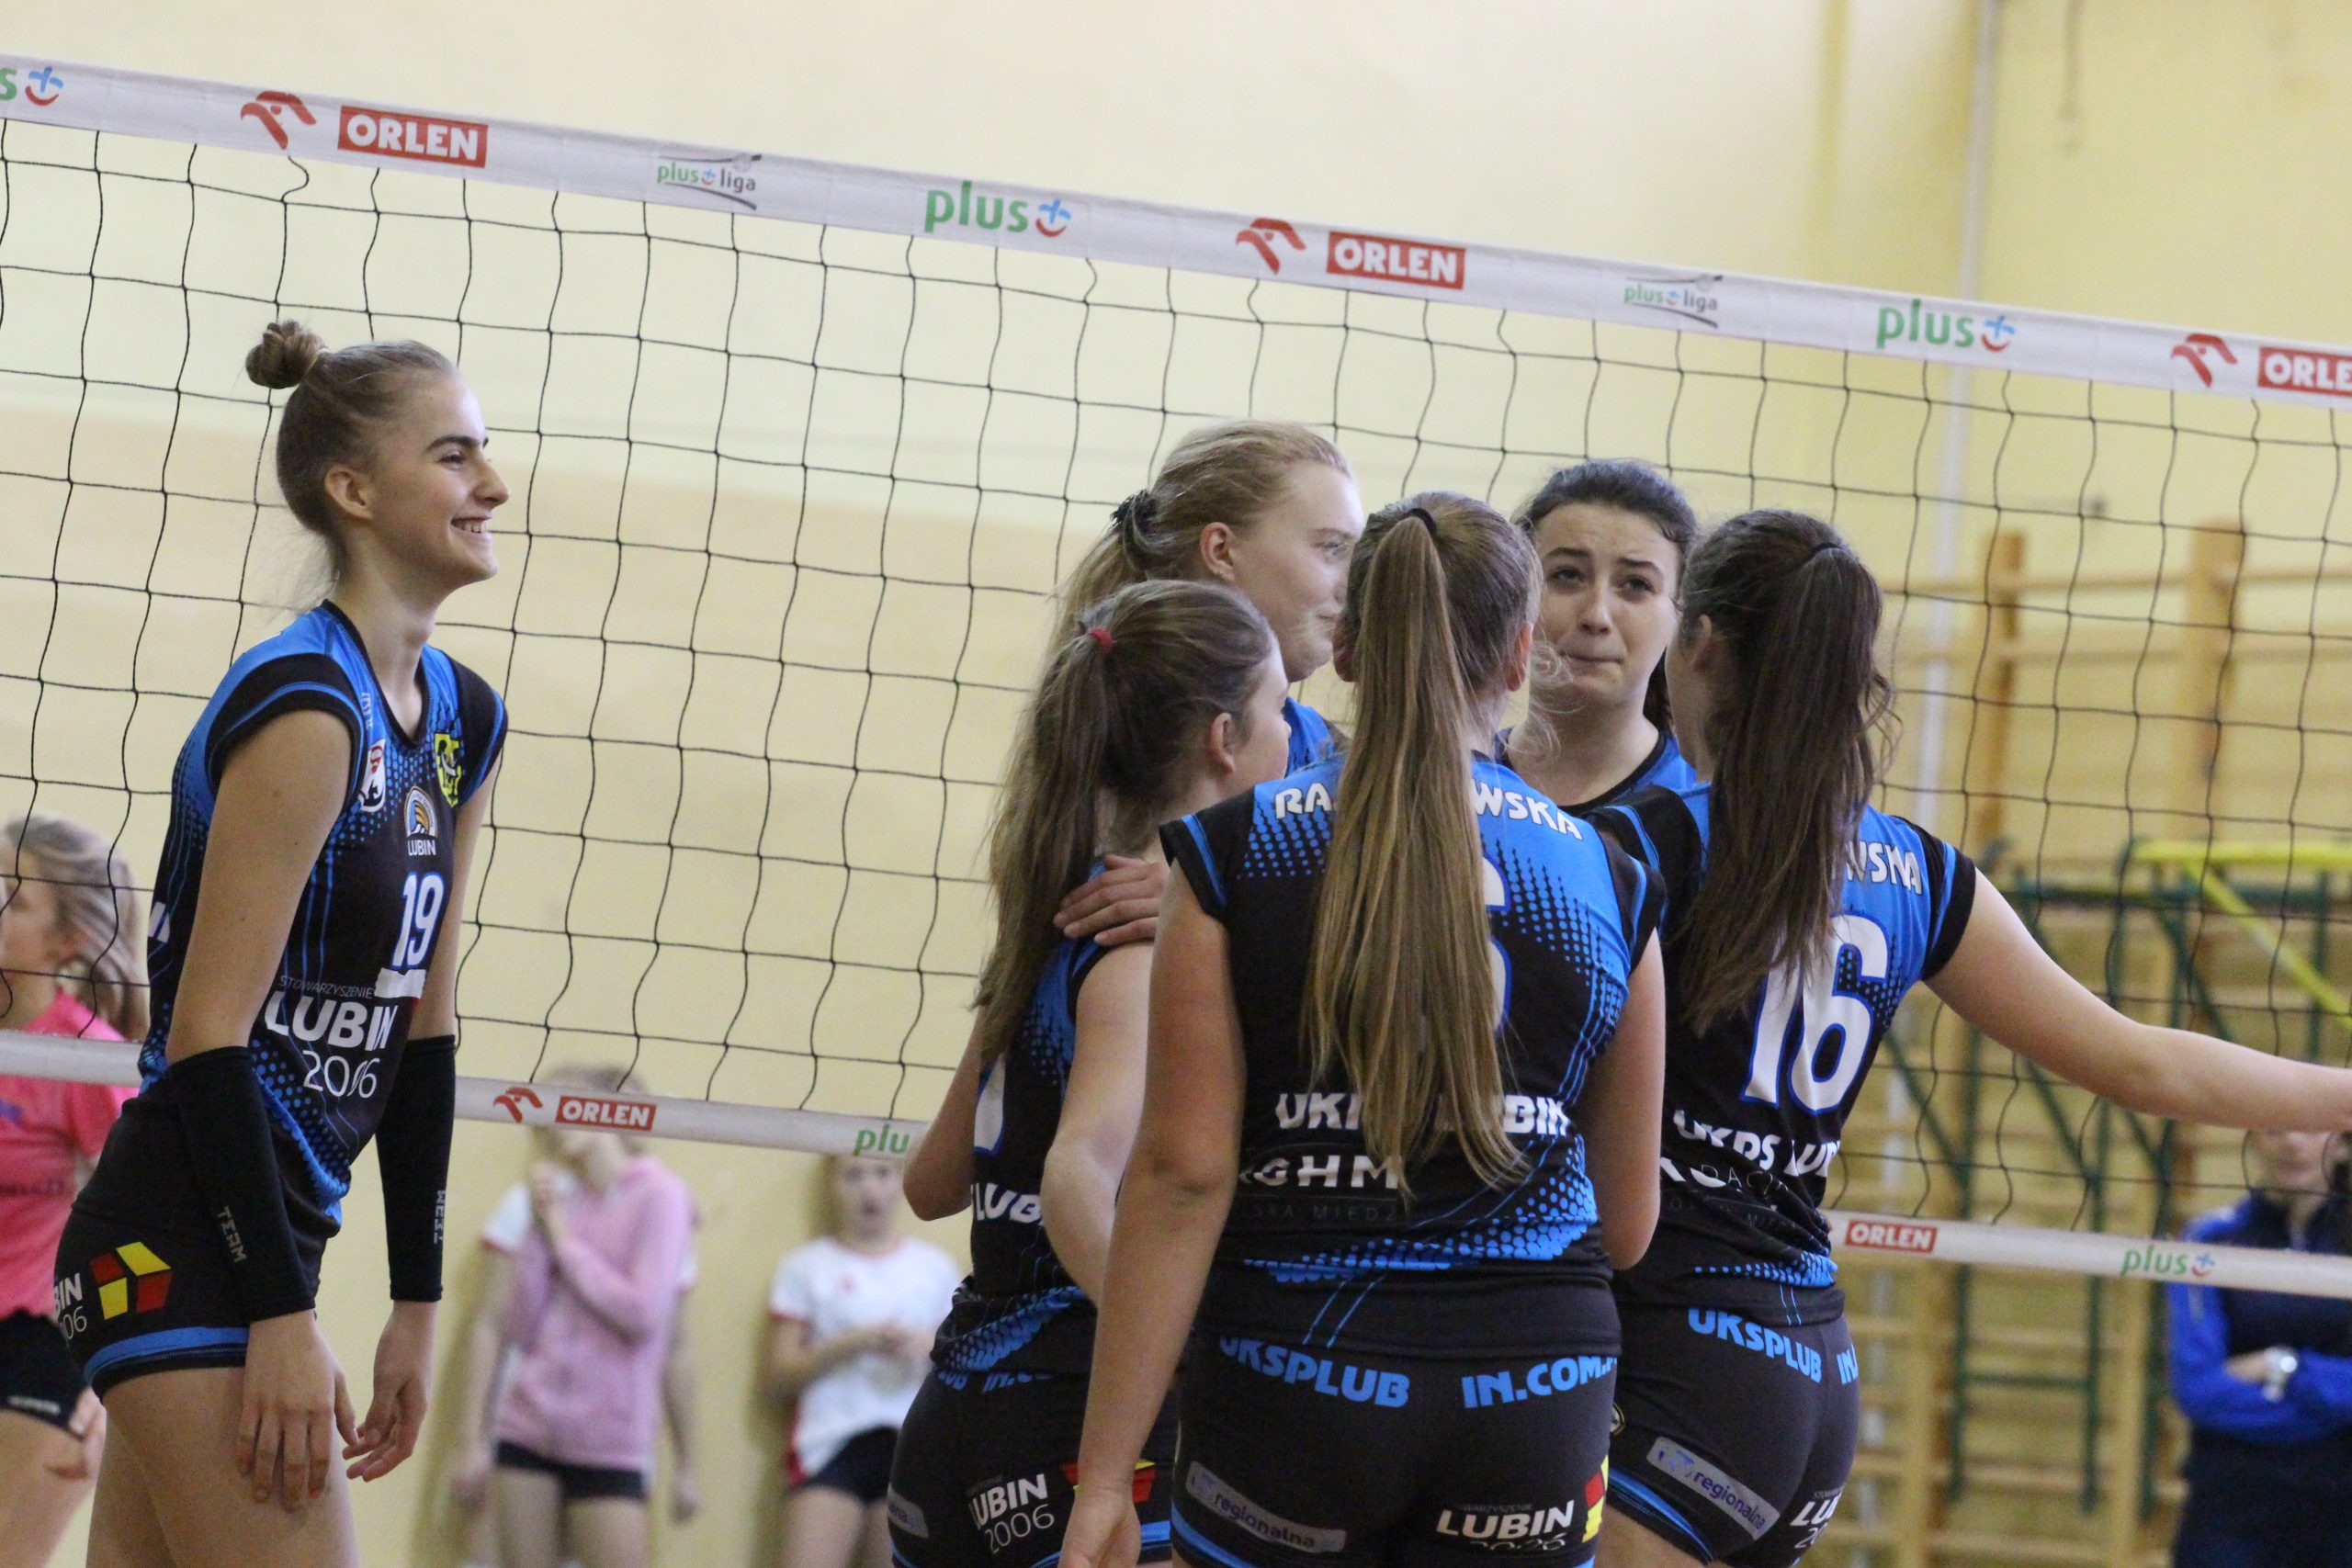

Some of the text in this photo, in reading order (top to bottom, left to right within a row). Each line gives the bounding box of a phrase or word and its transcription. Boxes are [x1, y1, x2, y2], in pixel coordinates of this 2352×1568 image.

[347, 115, 478, 161] ORLEN
[924, 180, 1028, 233] plus
[1335, 238, 1457, 283] ORLEN
[1877, 299, 1973, 348] plus
[2264, 353, 2352, 391] ORLE
[408, 840, 436, 856] LUBIN
[392, 874, 444, 967] 19
[265, 991, 398, 1051] LUBIN
[1744, 914, 1888, 1111] 16
[562, 1100, 651, 1128] ORLEN
[853, 1122, 910, 1156] plu
[1240, 1155, 1399, 1190] GHM
[1850, 1223, 1930, 1249] ORLEN
[2121, 1245, 2188, 1277] plus
[1689, 1307, 1822, 1383] UKSPLUB
[984, 1503, 1055, 1555] 2006
[1436, 1499, 1575, 1540] LUBIN
